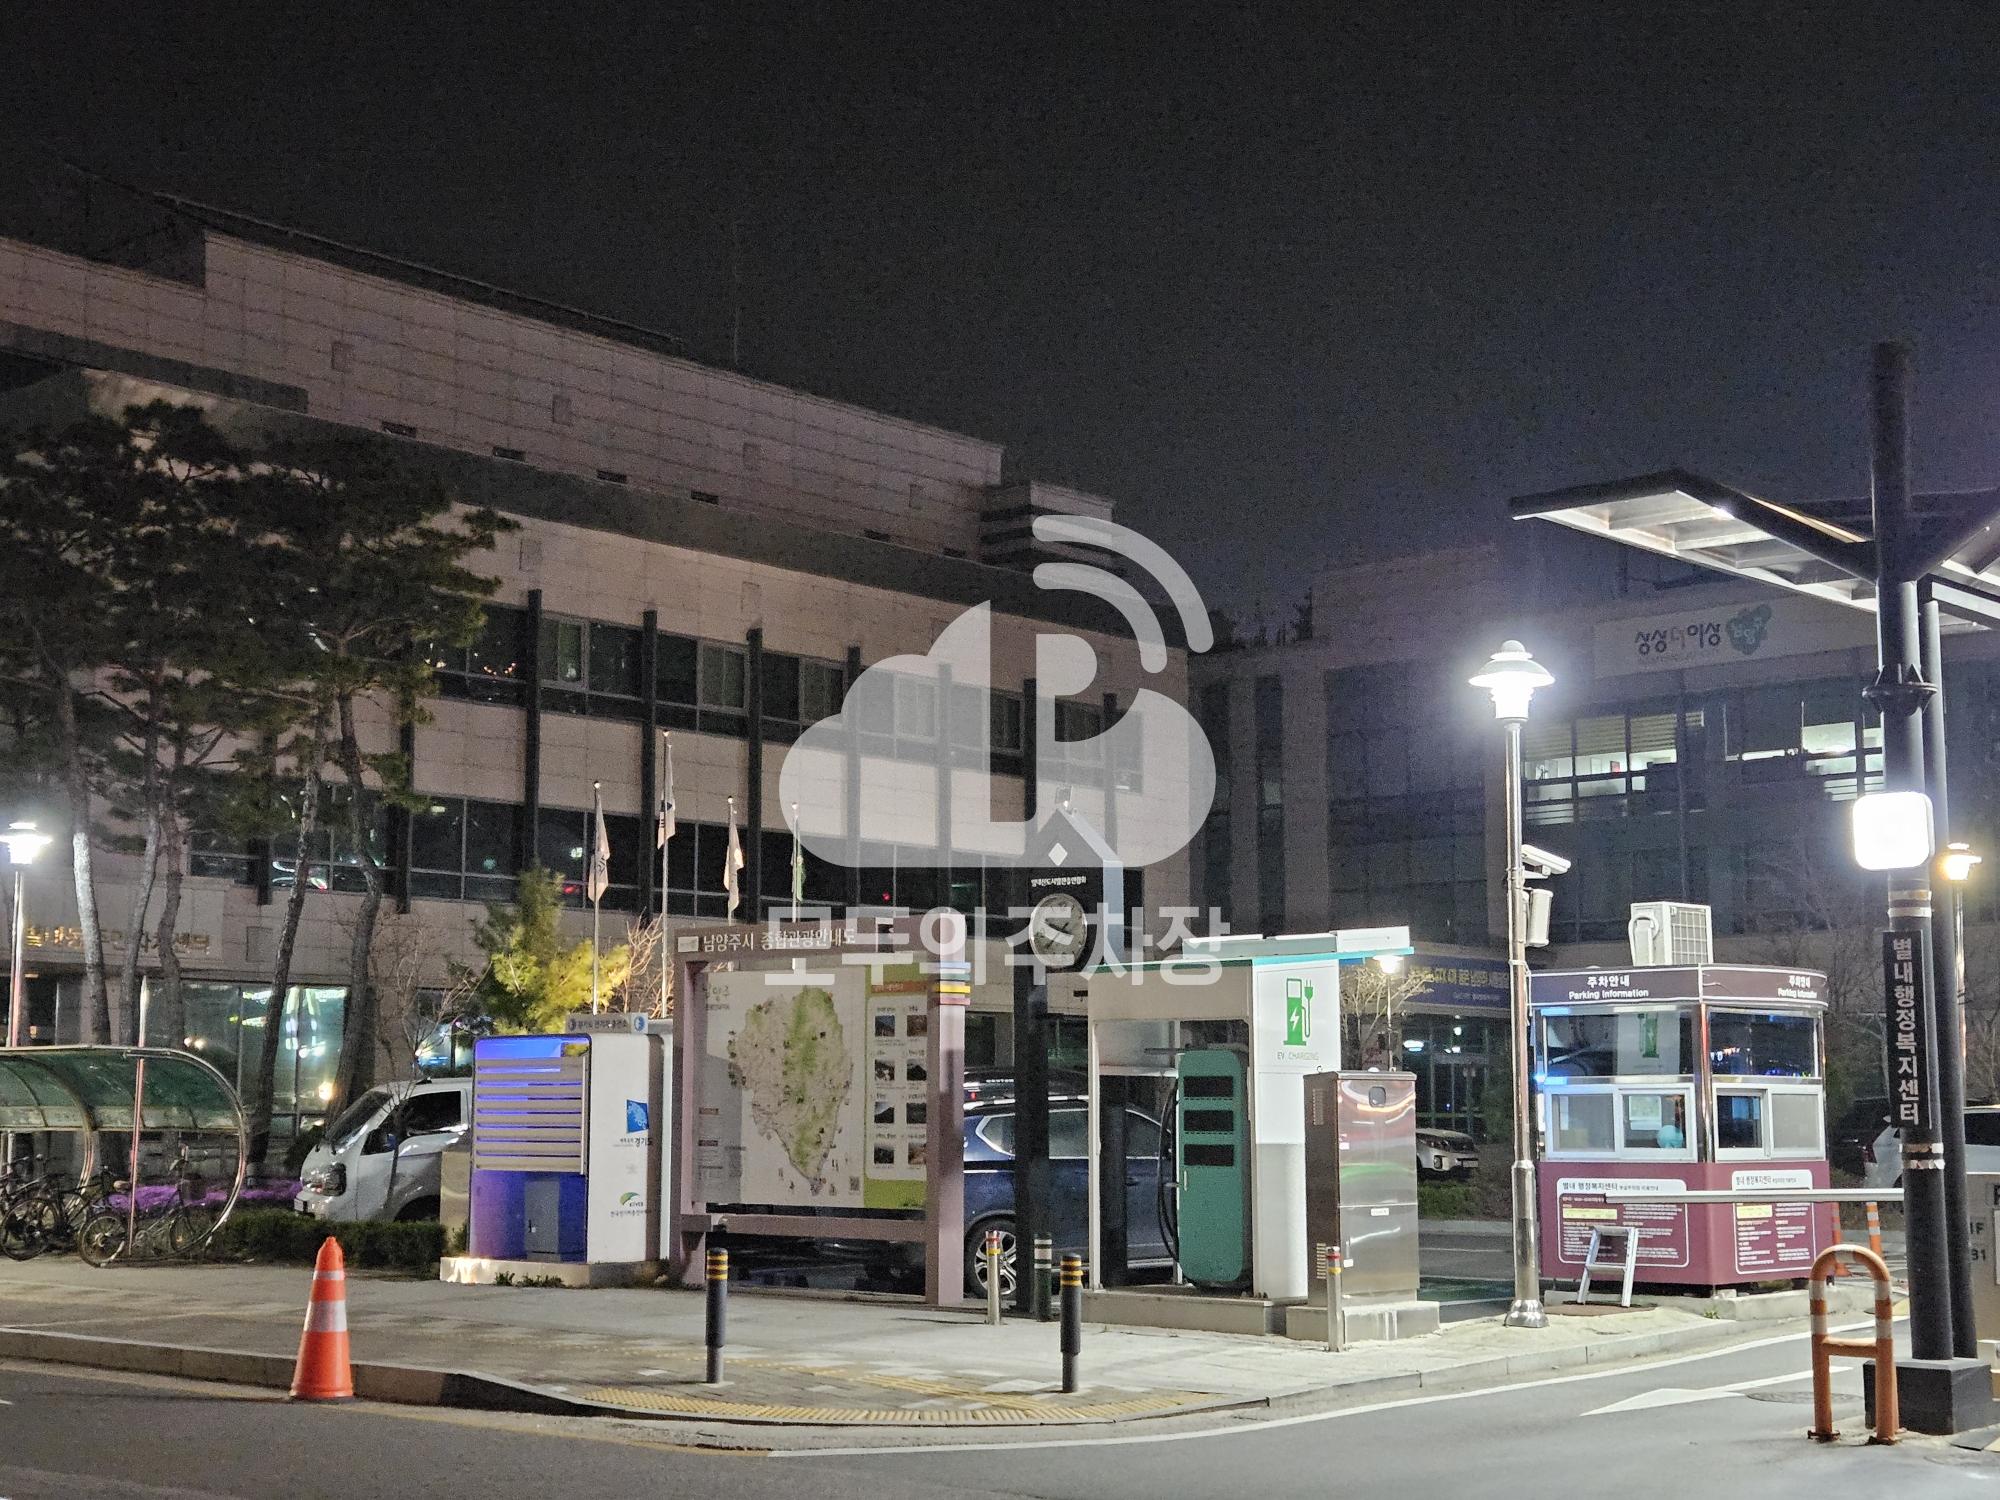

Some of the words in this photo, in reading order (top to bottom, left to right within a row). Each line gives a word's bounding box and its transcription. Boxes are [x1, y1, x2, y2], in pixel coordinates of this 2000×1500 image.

[703, 932, 754, 952] 남양주시
[761, 927, 856, 951] 종합관광안내도
[1587, 975, 1630, 988] 주차안내
[1569, 990, 1600, 1000] Parking
[1602, 989, 1649, 999] Information
[1893, 938, 1920, 1126] 별내행정복지센터
[1562, 1182, 1576, 1191] 별내
[1578, 1182, 1618, 1191] 행정복지센터
